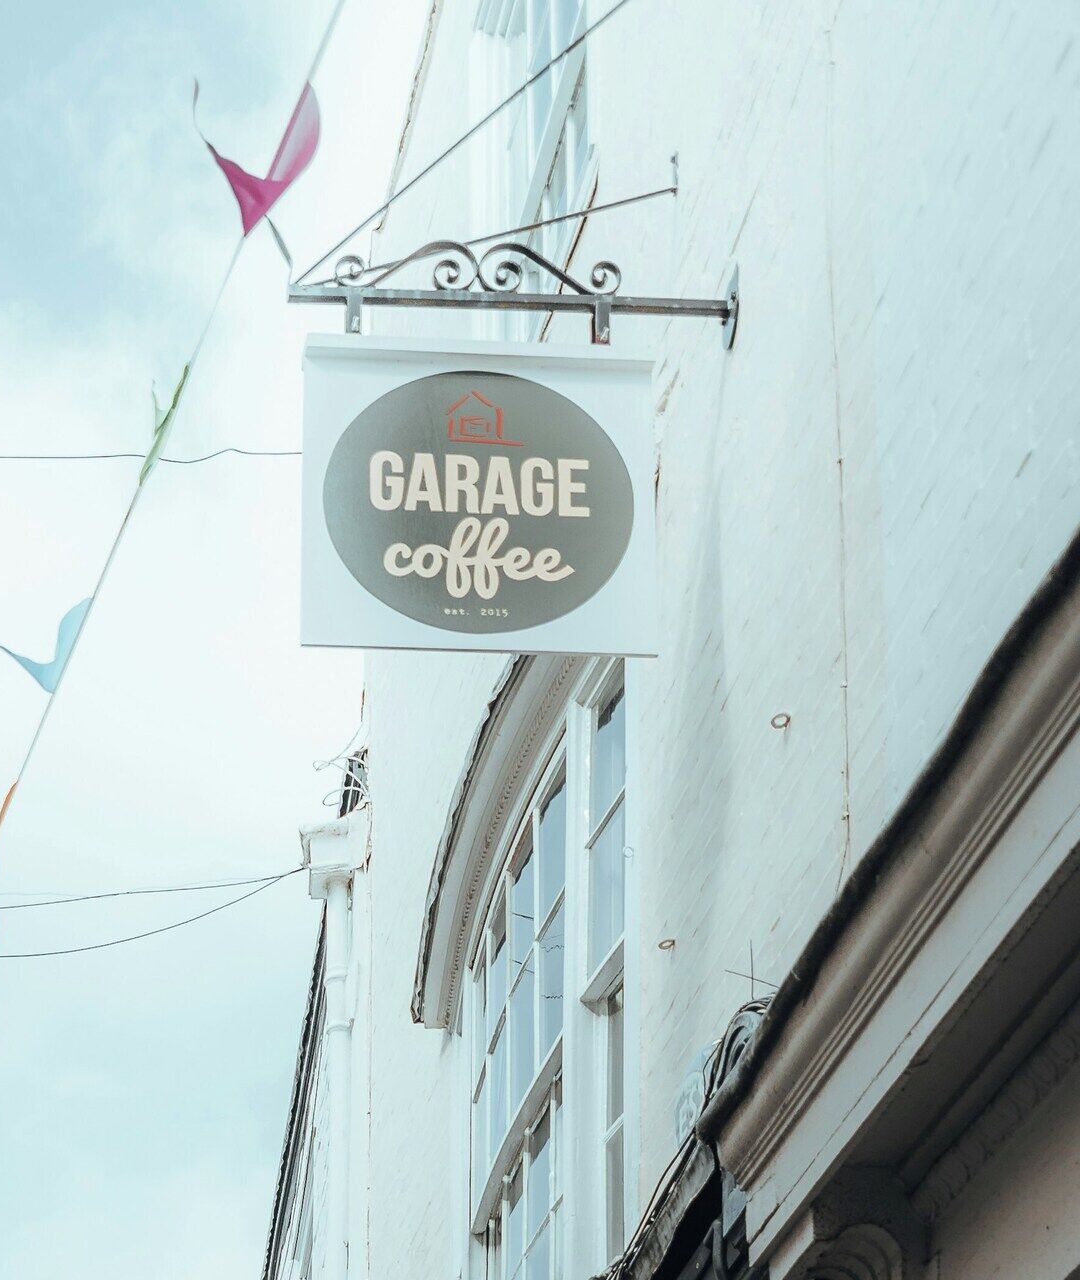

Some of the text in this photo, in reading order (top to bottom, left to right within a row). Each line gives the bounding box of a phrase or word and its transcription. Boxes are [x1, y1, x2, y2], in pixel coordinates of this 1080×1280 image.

[369, 450, 590, 518] GARAGE
[384, 517, 575, 600] coffee
[443, 607, 509, 618] est. 2015
